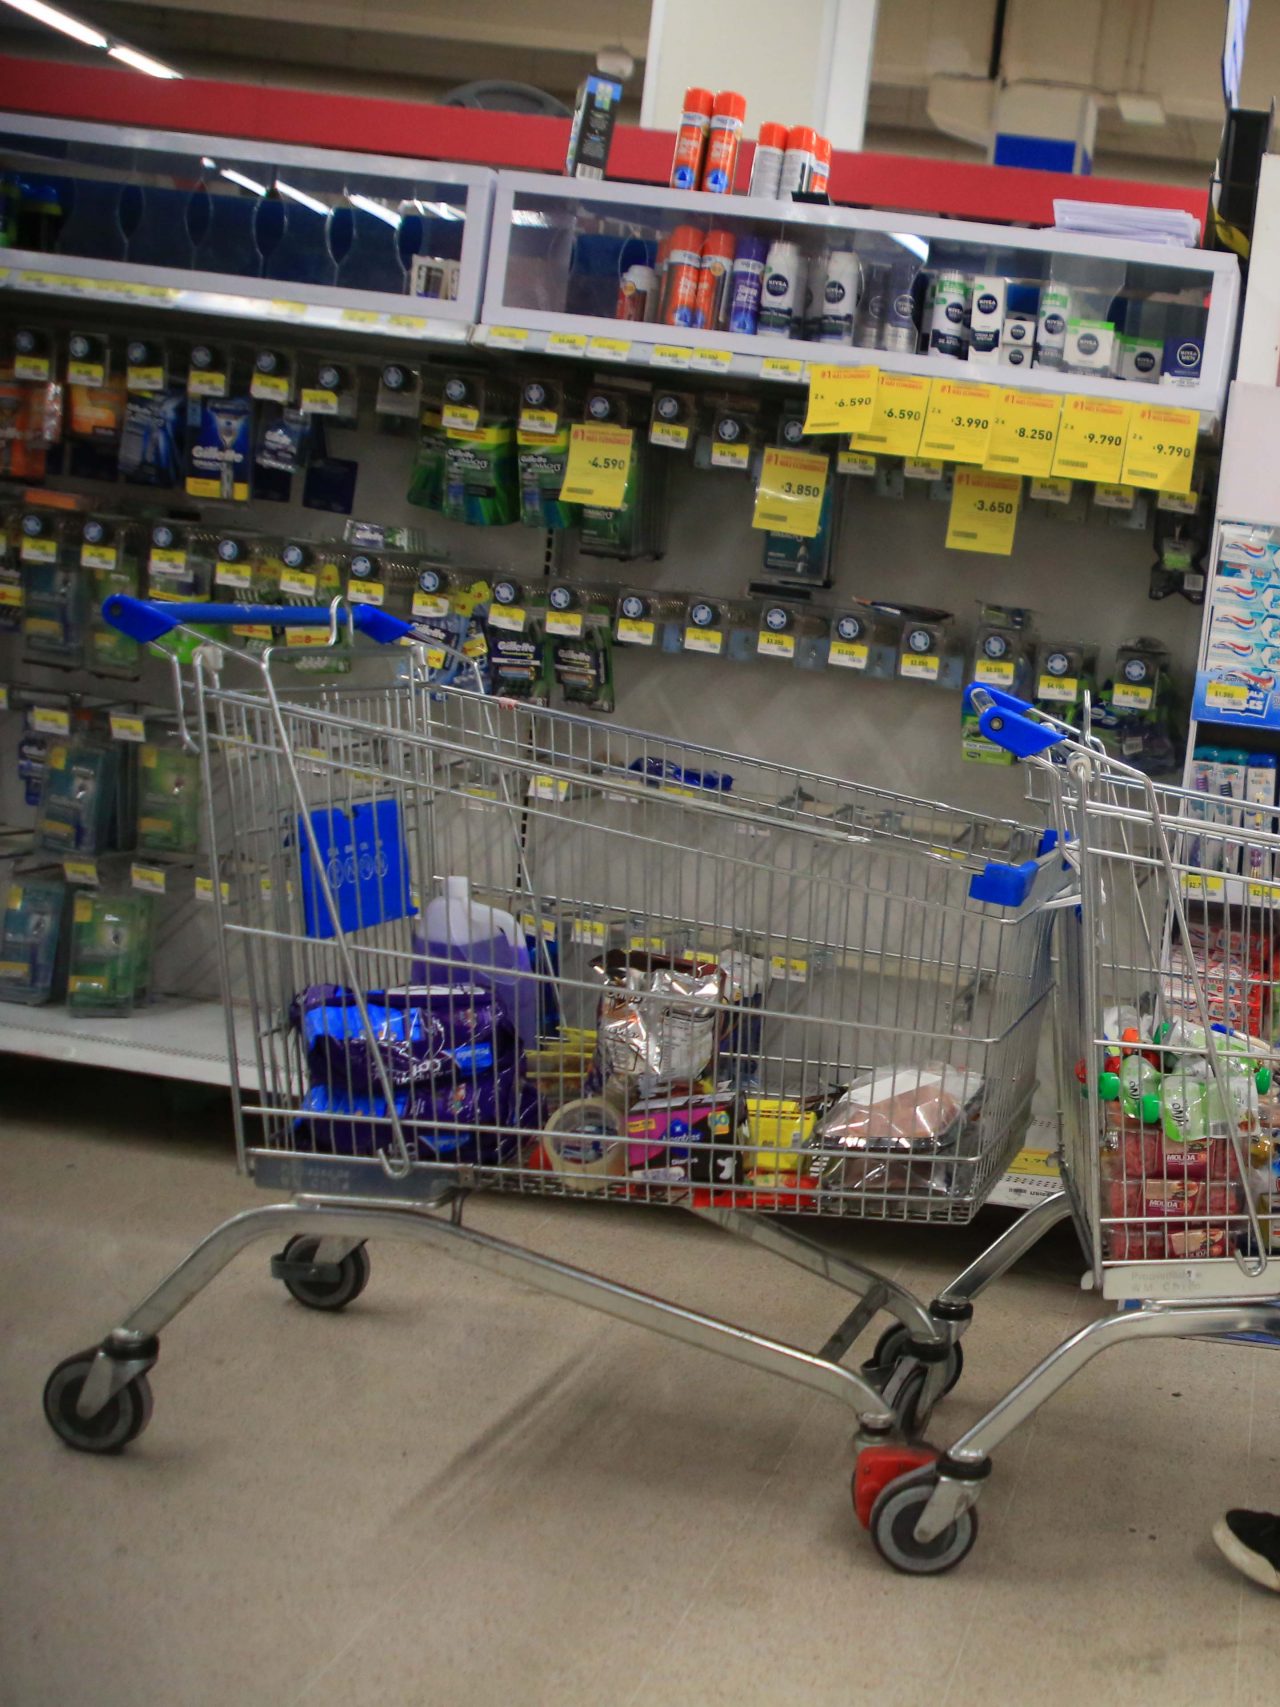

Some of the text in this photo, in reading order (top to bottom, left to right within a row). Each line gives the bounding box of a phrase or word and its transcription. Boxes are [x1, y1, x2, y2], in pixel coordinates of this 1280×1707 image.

[880, 376, 885, 386] 1
[838, 396, 872, 408] 6.590
[886, 408, 921, 422] 6.590
[955, 416, 990, 430] 3.990
[1018, 427, 1053, 441] 8.250
[1088, 433, 1122, 447] 9.790
[1156, 443, 1191, 459] 9.790
[592, 456, 626, 470] 4.590
[784, 482, 820, 498] 3.850
[977, 500, 1013, 515] 3.650
